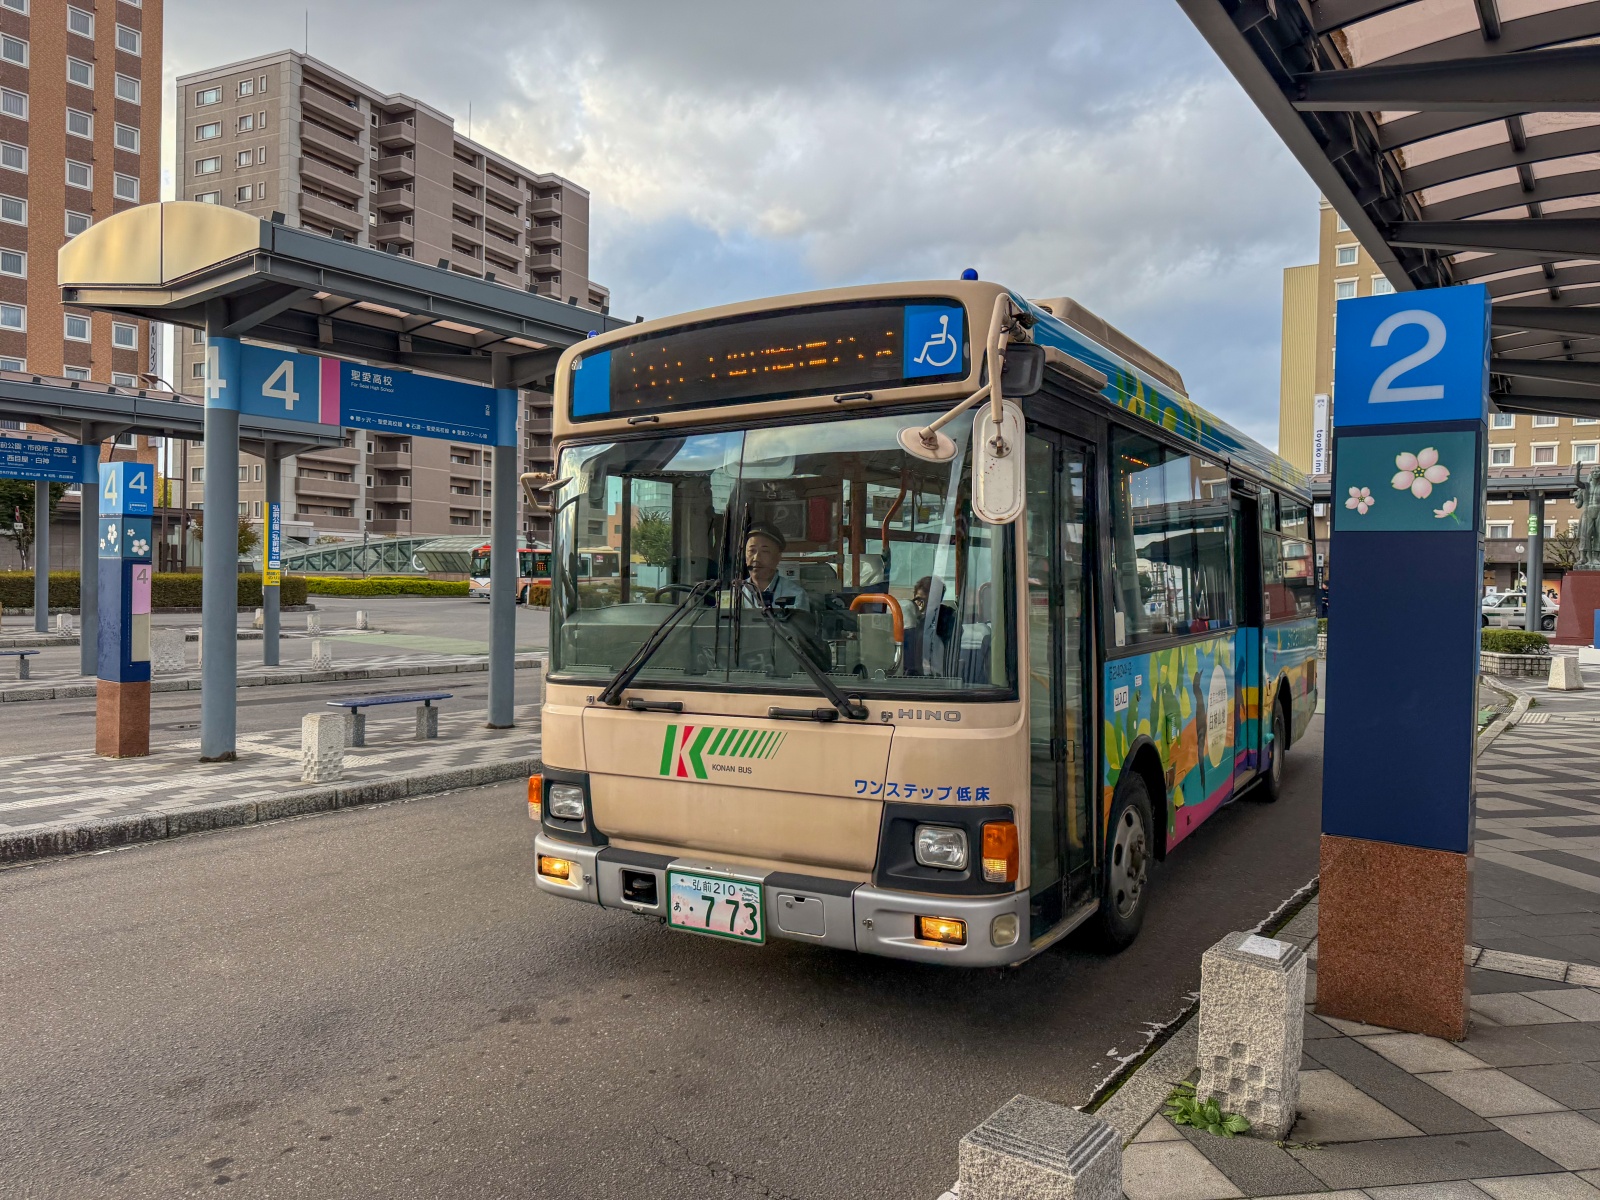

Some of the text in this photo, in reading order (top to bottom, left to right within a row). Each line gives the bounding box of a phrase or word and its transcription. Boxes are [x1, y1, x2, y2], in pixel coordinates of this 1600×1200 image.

[1368, 309, 1447, 404] 2
[262, 360, 299, 410] 4
[350, 369, 393, 386] 聖愛高校
[1315, 429, 1323, 458] toyoko
[104, 469, 118, 507] 4
[129, 471, 148, 494] 4
[137, 568, 148, 584] 4
[898, 708, 962, 723] HINO
[712, 763, 752, 775] KONAN BUS
[854, 779, 990, 802] ワンステップ低床
[673, 902, 682, 913] あ
